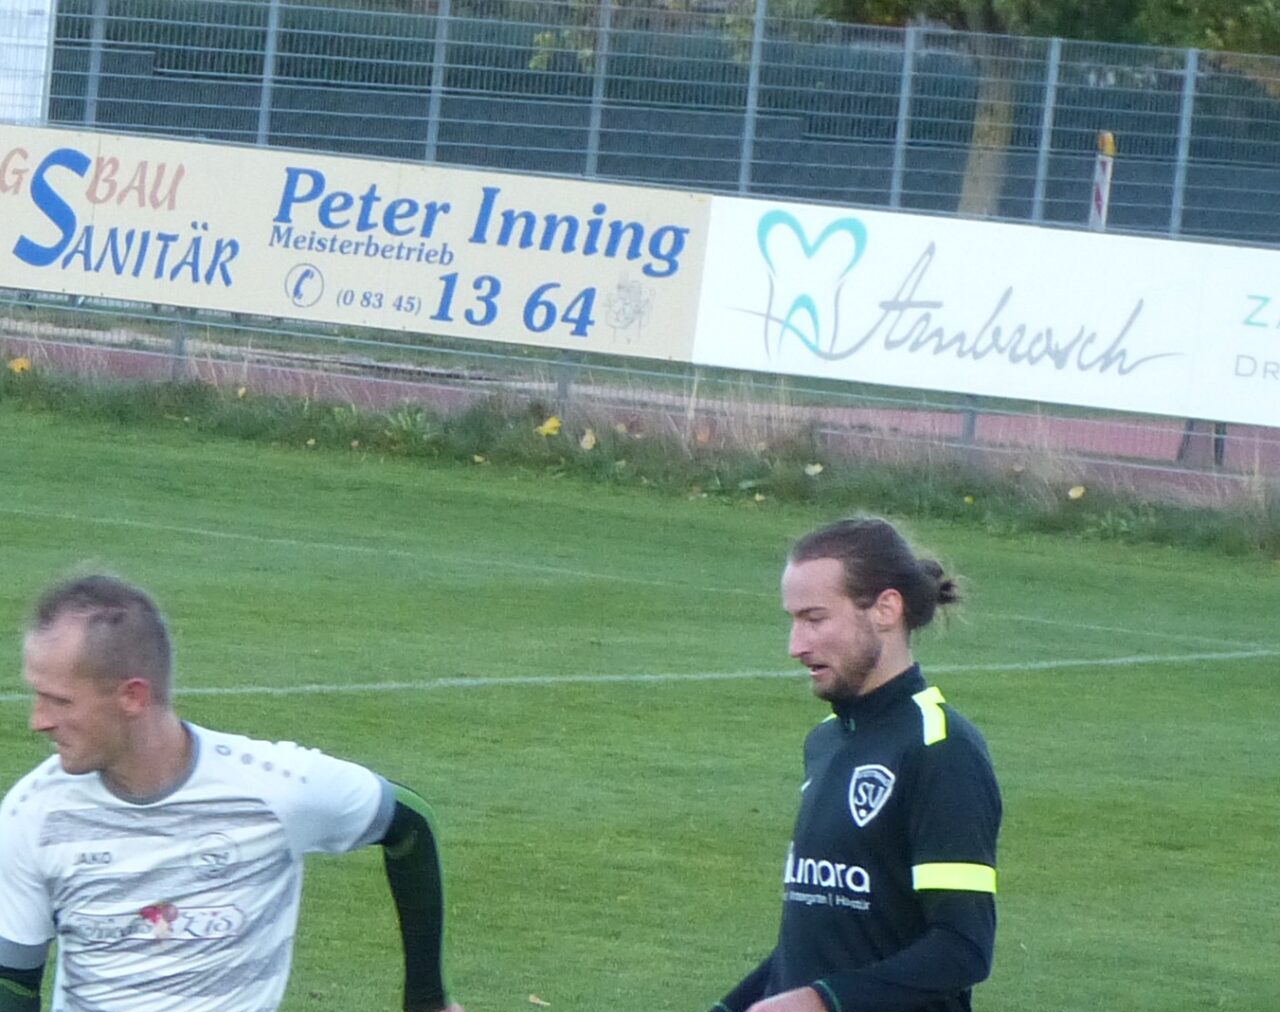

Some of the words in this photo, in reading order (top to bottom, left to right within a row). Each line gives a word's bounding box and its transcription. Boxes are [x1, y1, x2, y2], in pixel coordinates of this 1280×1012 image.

[268, 224, 455, 266] Meisterbetrieb
[272, 165, 451, 239] Peter
[468, 186, 690, 278] Inning
[359, 290, 384, 309] 83
[392, 294, 422, 316] 45)
[429, 271, 502, 327] 13
[522, 281, 598, 338] 64
[865, 241, 1185, 377] Ambrosch
